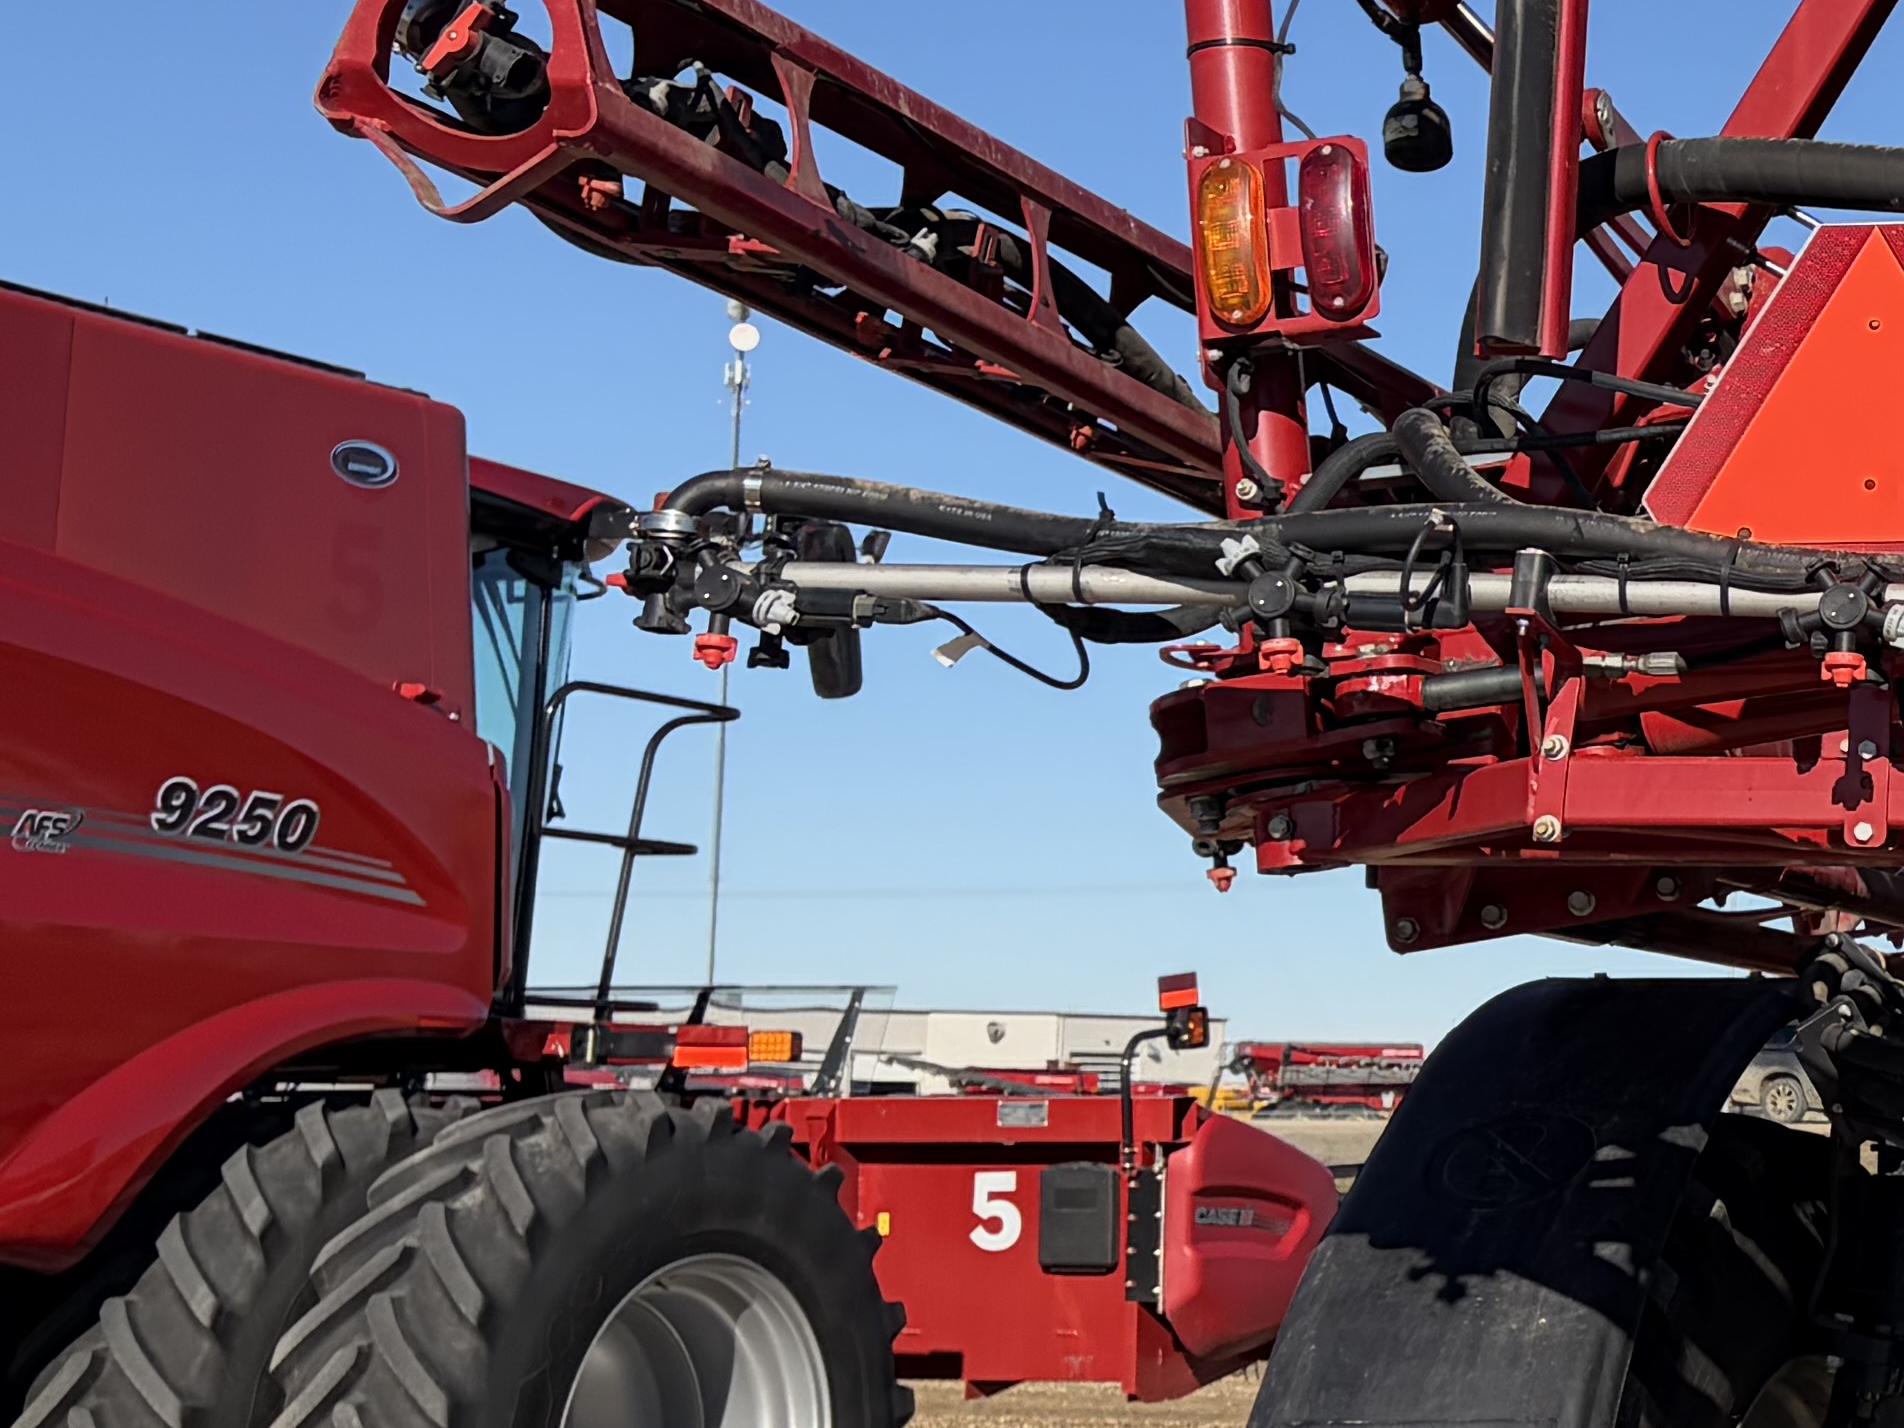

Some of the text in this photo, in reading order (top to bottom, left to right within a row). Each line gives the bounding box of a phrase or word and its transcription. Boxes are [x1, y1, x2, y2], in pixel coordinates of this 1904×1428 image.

[11, 808, 72, 839] AFS
[151, 776, 322, 854] 9250
[969, 1170, 1022, 1252] 5
